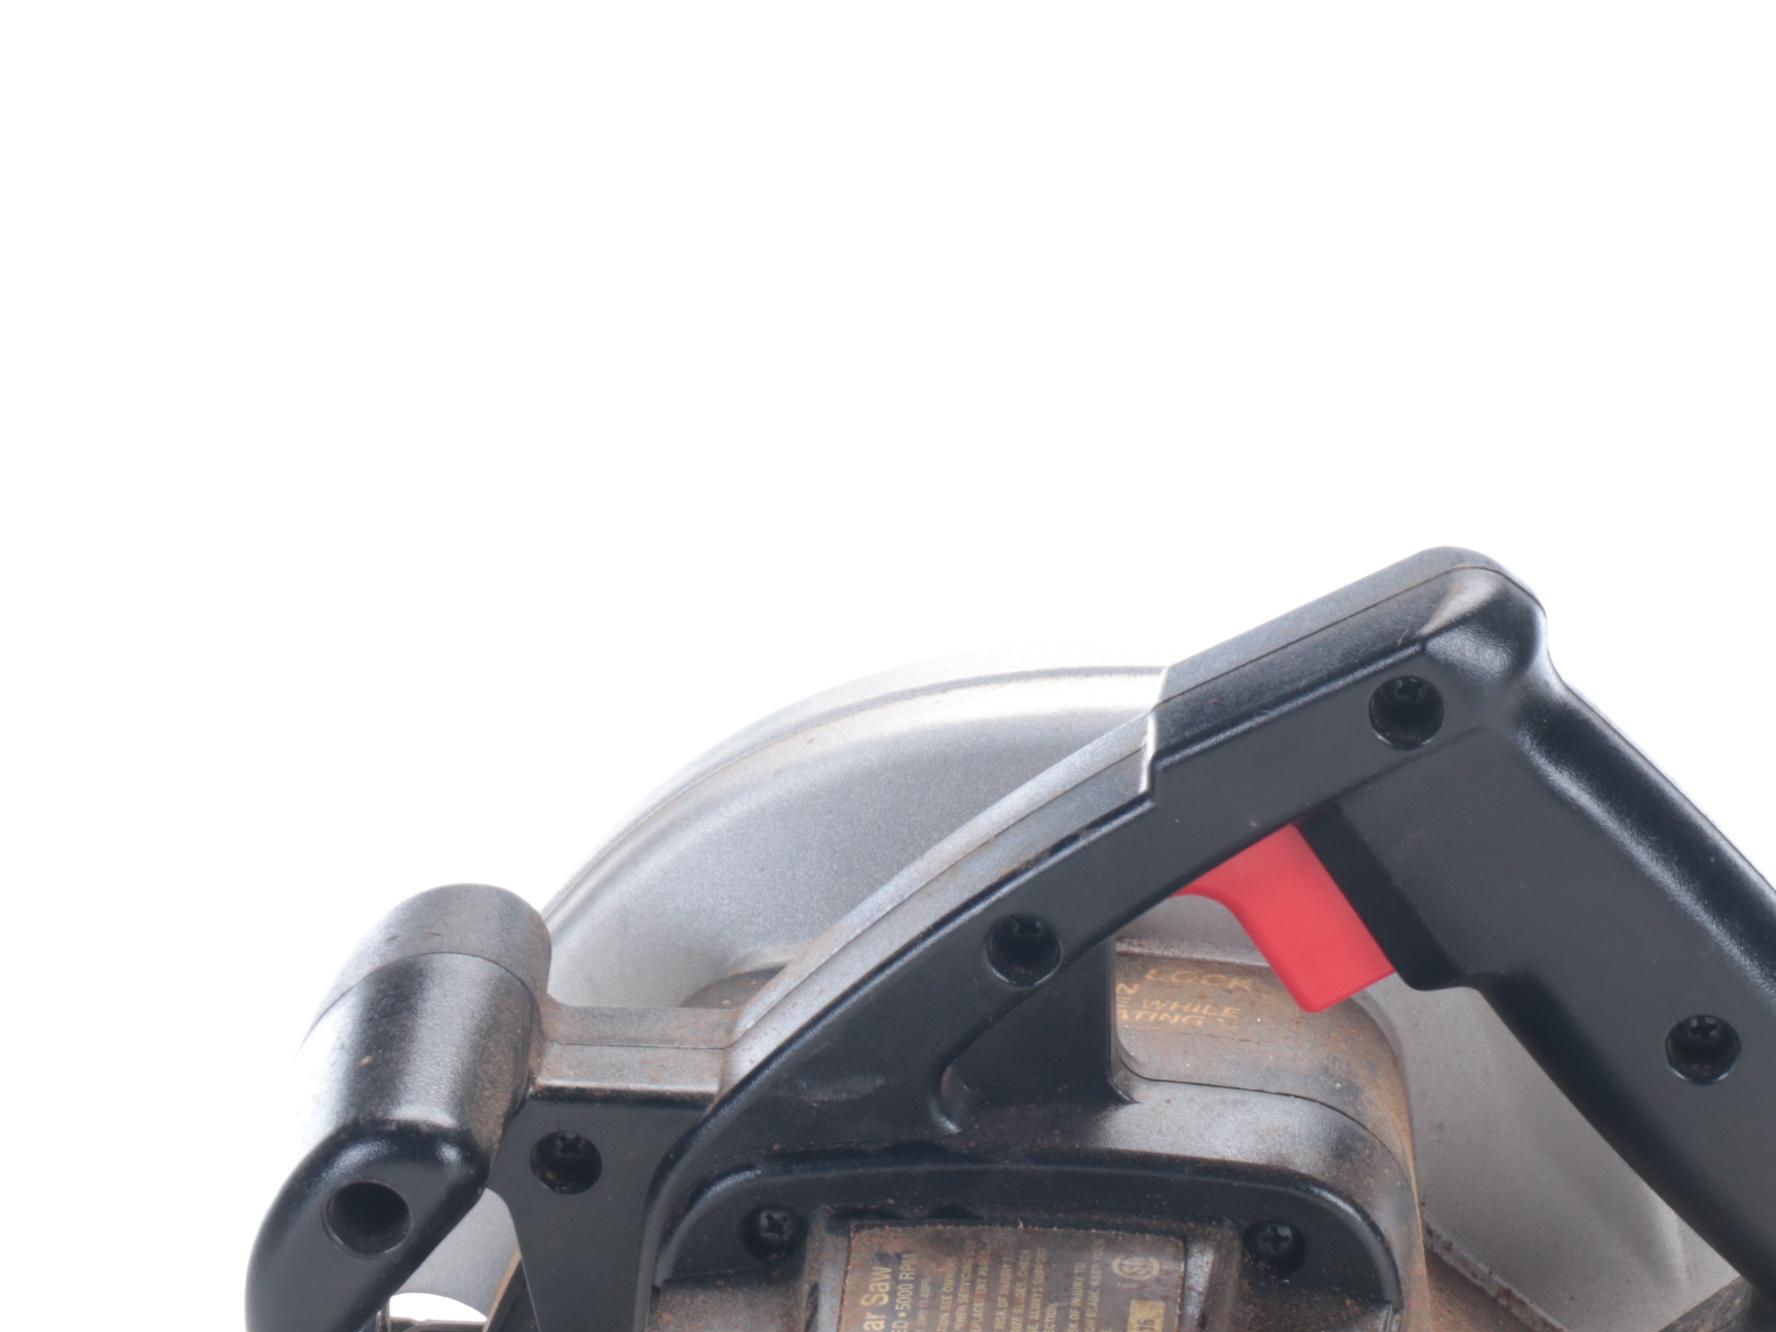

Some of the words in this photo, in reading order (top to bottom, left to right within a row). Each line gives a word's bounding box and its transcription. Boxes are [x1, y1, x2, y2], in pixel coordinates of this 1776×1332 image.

[1141, 1000, 1241, 1019] WHILE
[897, 1252, 919, 1281] RPM
[1031, 1246, 1049, 1286] SUPPORT
[1073, 1261, 1087, 1274] TO
[1088, 1261, 1104, 1286] KEEP
[858, 1264, 893, 1307] Saw
[893, 1282, 914, 1311] 5000
[1069, 1274, 1086, 1307] INJURY
[938, 1293, 953, 1311] SEE
[995, 1295, 1009, 1307] OF
[953, 1303, 968, 1329] WHEN
[993, 1307, 1008, 1329] RISK
[1068, 1307, 1082, 1321] OF
